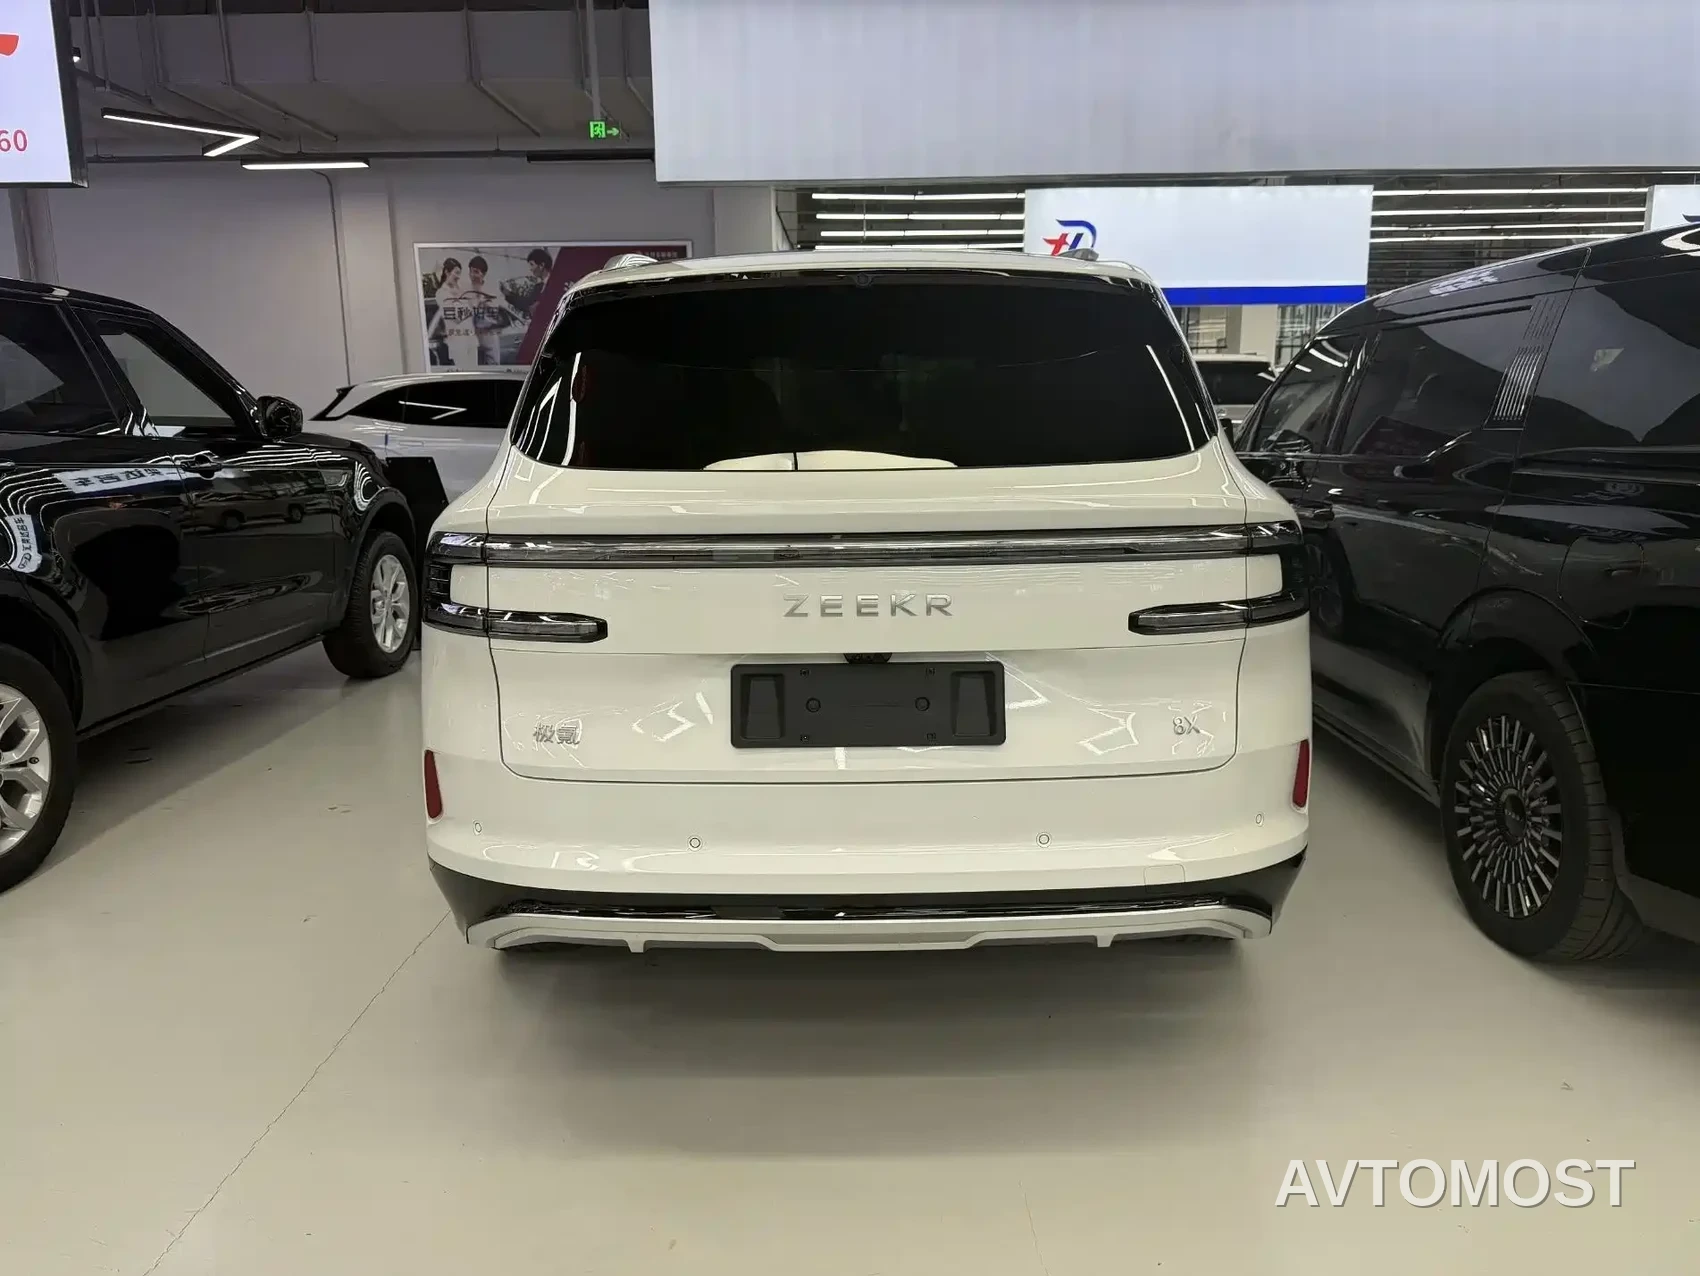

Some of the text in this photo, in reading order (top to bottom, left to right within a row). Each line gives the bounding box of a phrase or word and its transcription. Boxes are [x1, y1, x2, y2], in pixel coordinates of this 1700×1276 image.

[783, 594, 953, 617] ZEEKR
[533, 723, 580, 744] 极氪
[1172, 716, 1201, 735] 8X
